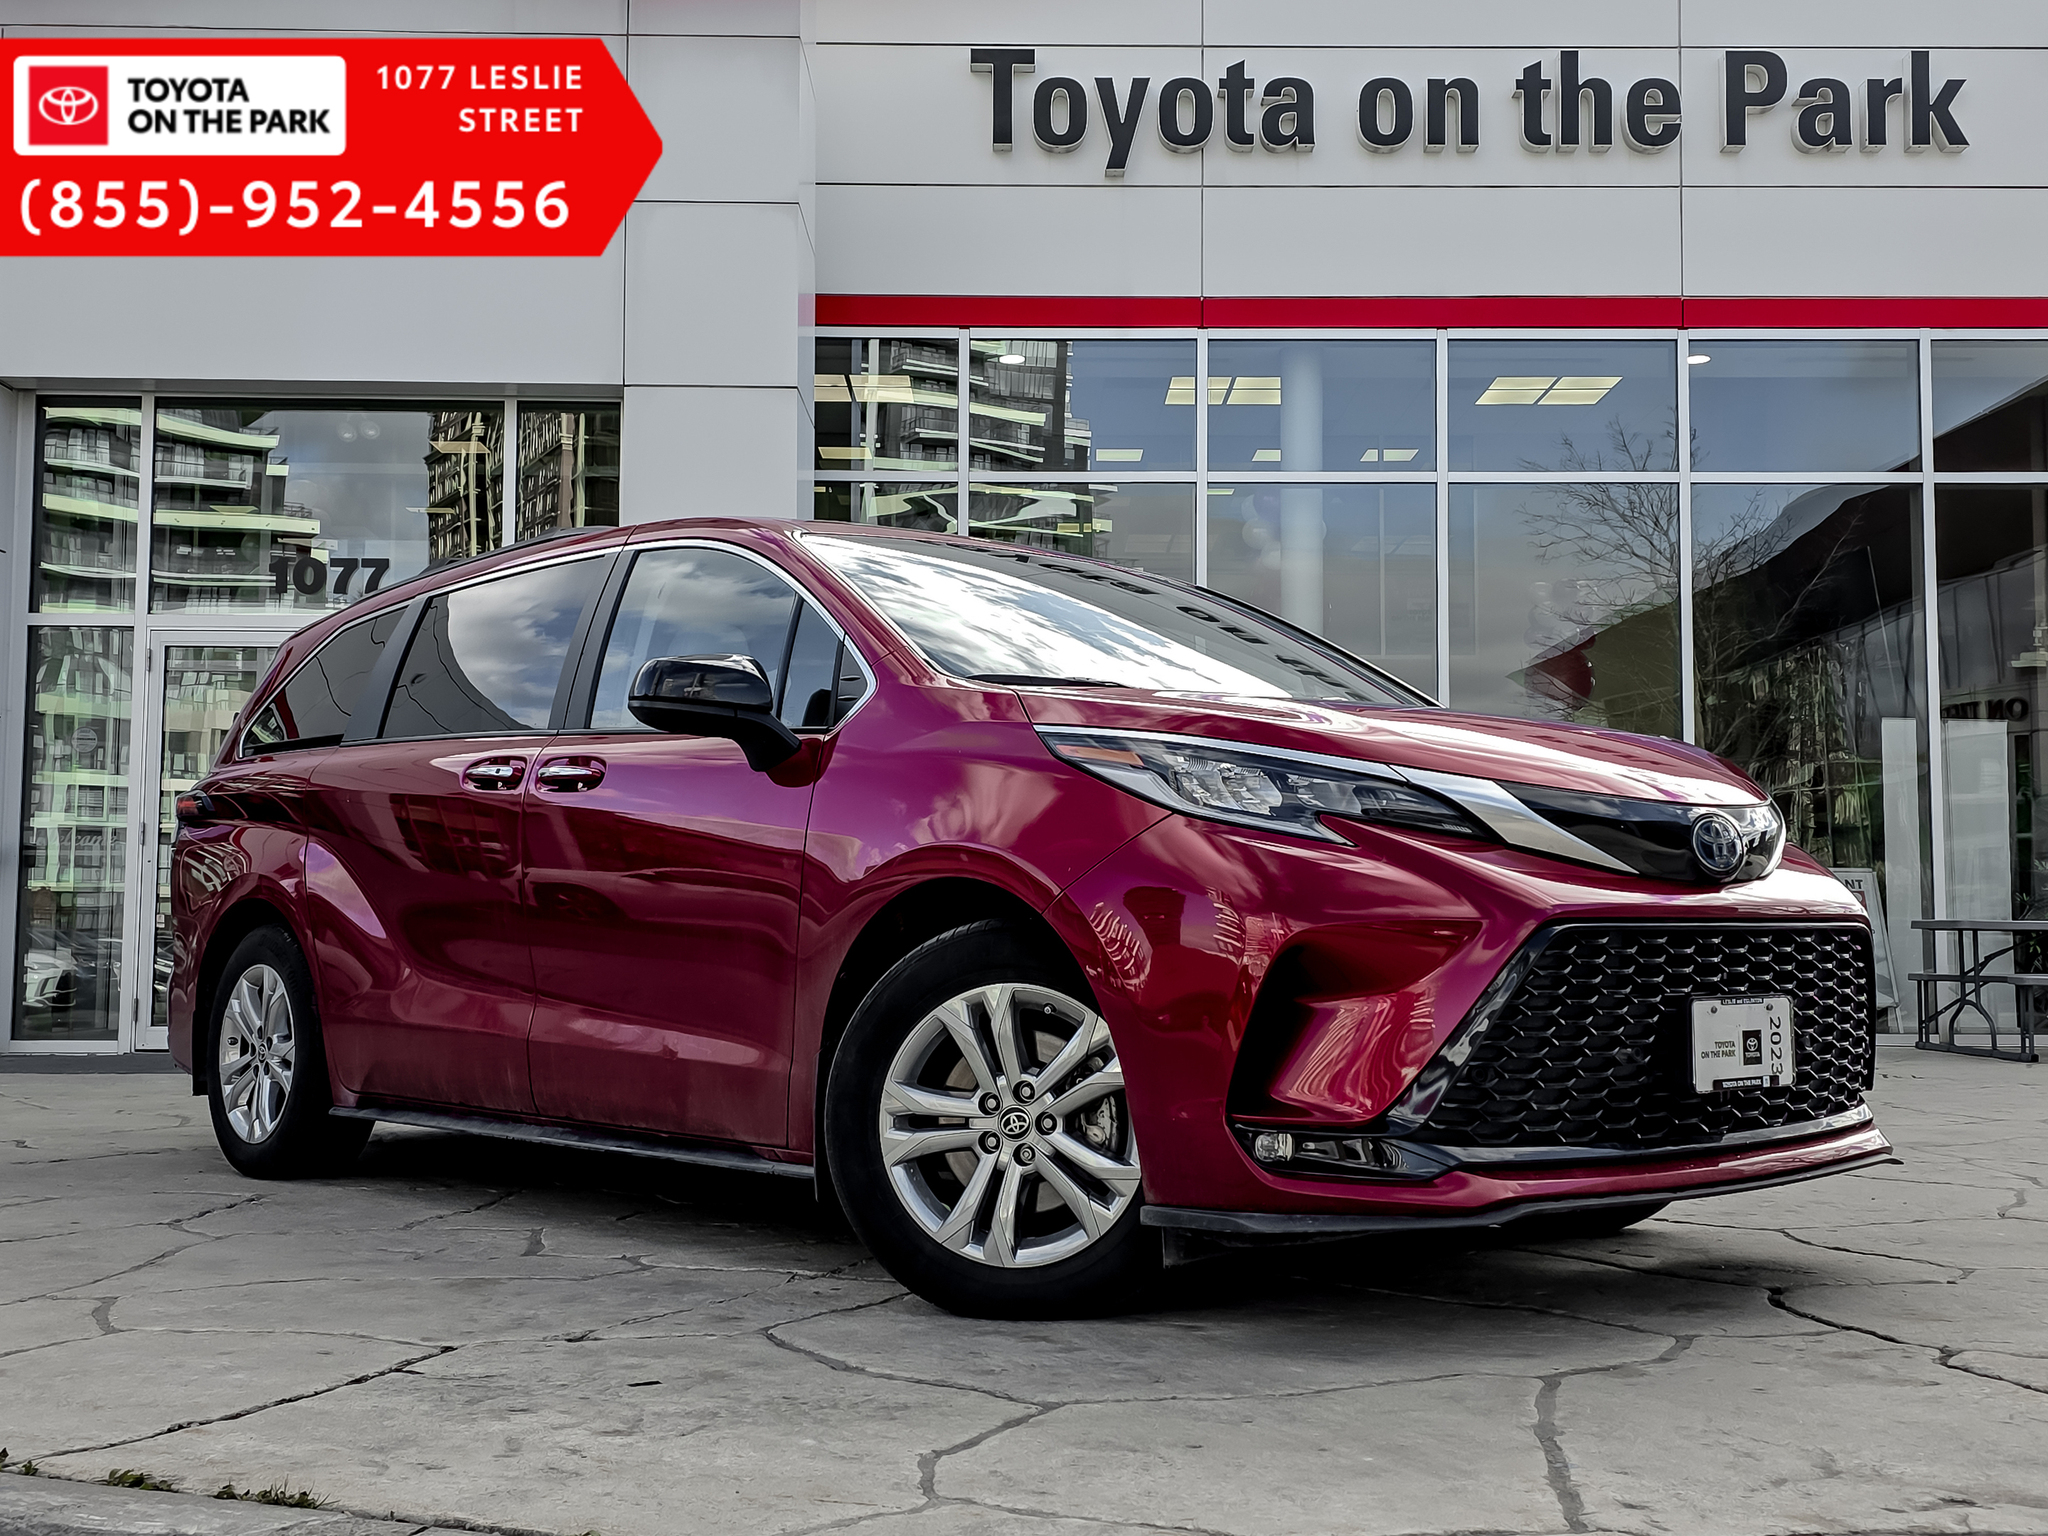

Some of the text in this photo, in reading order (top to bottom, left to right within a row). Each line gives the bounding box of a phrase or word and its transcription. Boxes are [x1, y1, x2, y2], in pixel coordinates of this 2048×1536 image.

[970, 48, 1970, 177] Toyota on the Park
[269, 556, 390, 594] 1077
[1701, 1049, 1736, 1059] ON THE PARK
[1715, 1041, 1736, 1049] TOYOTA
[1769, 1016, 1784, 1075] 2023
